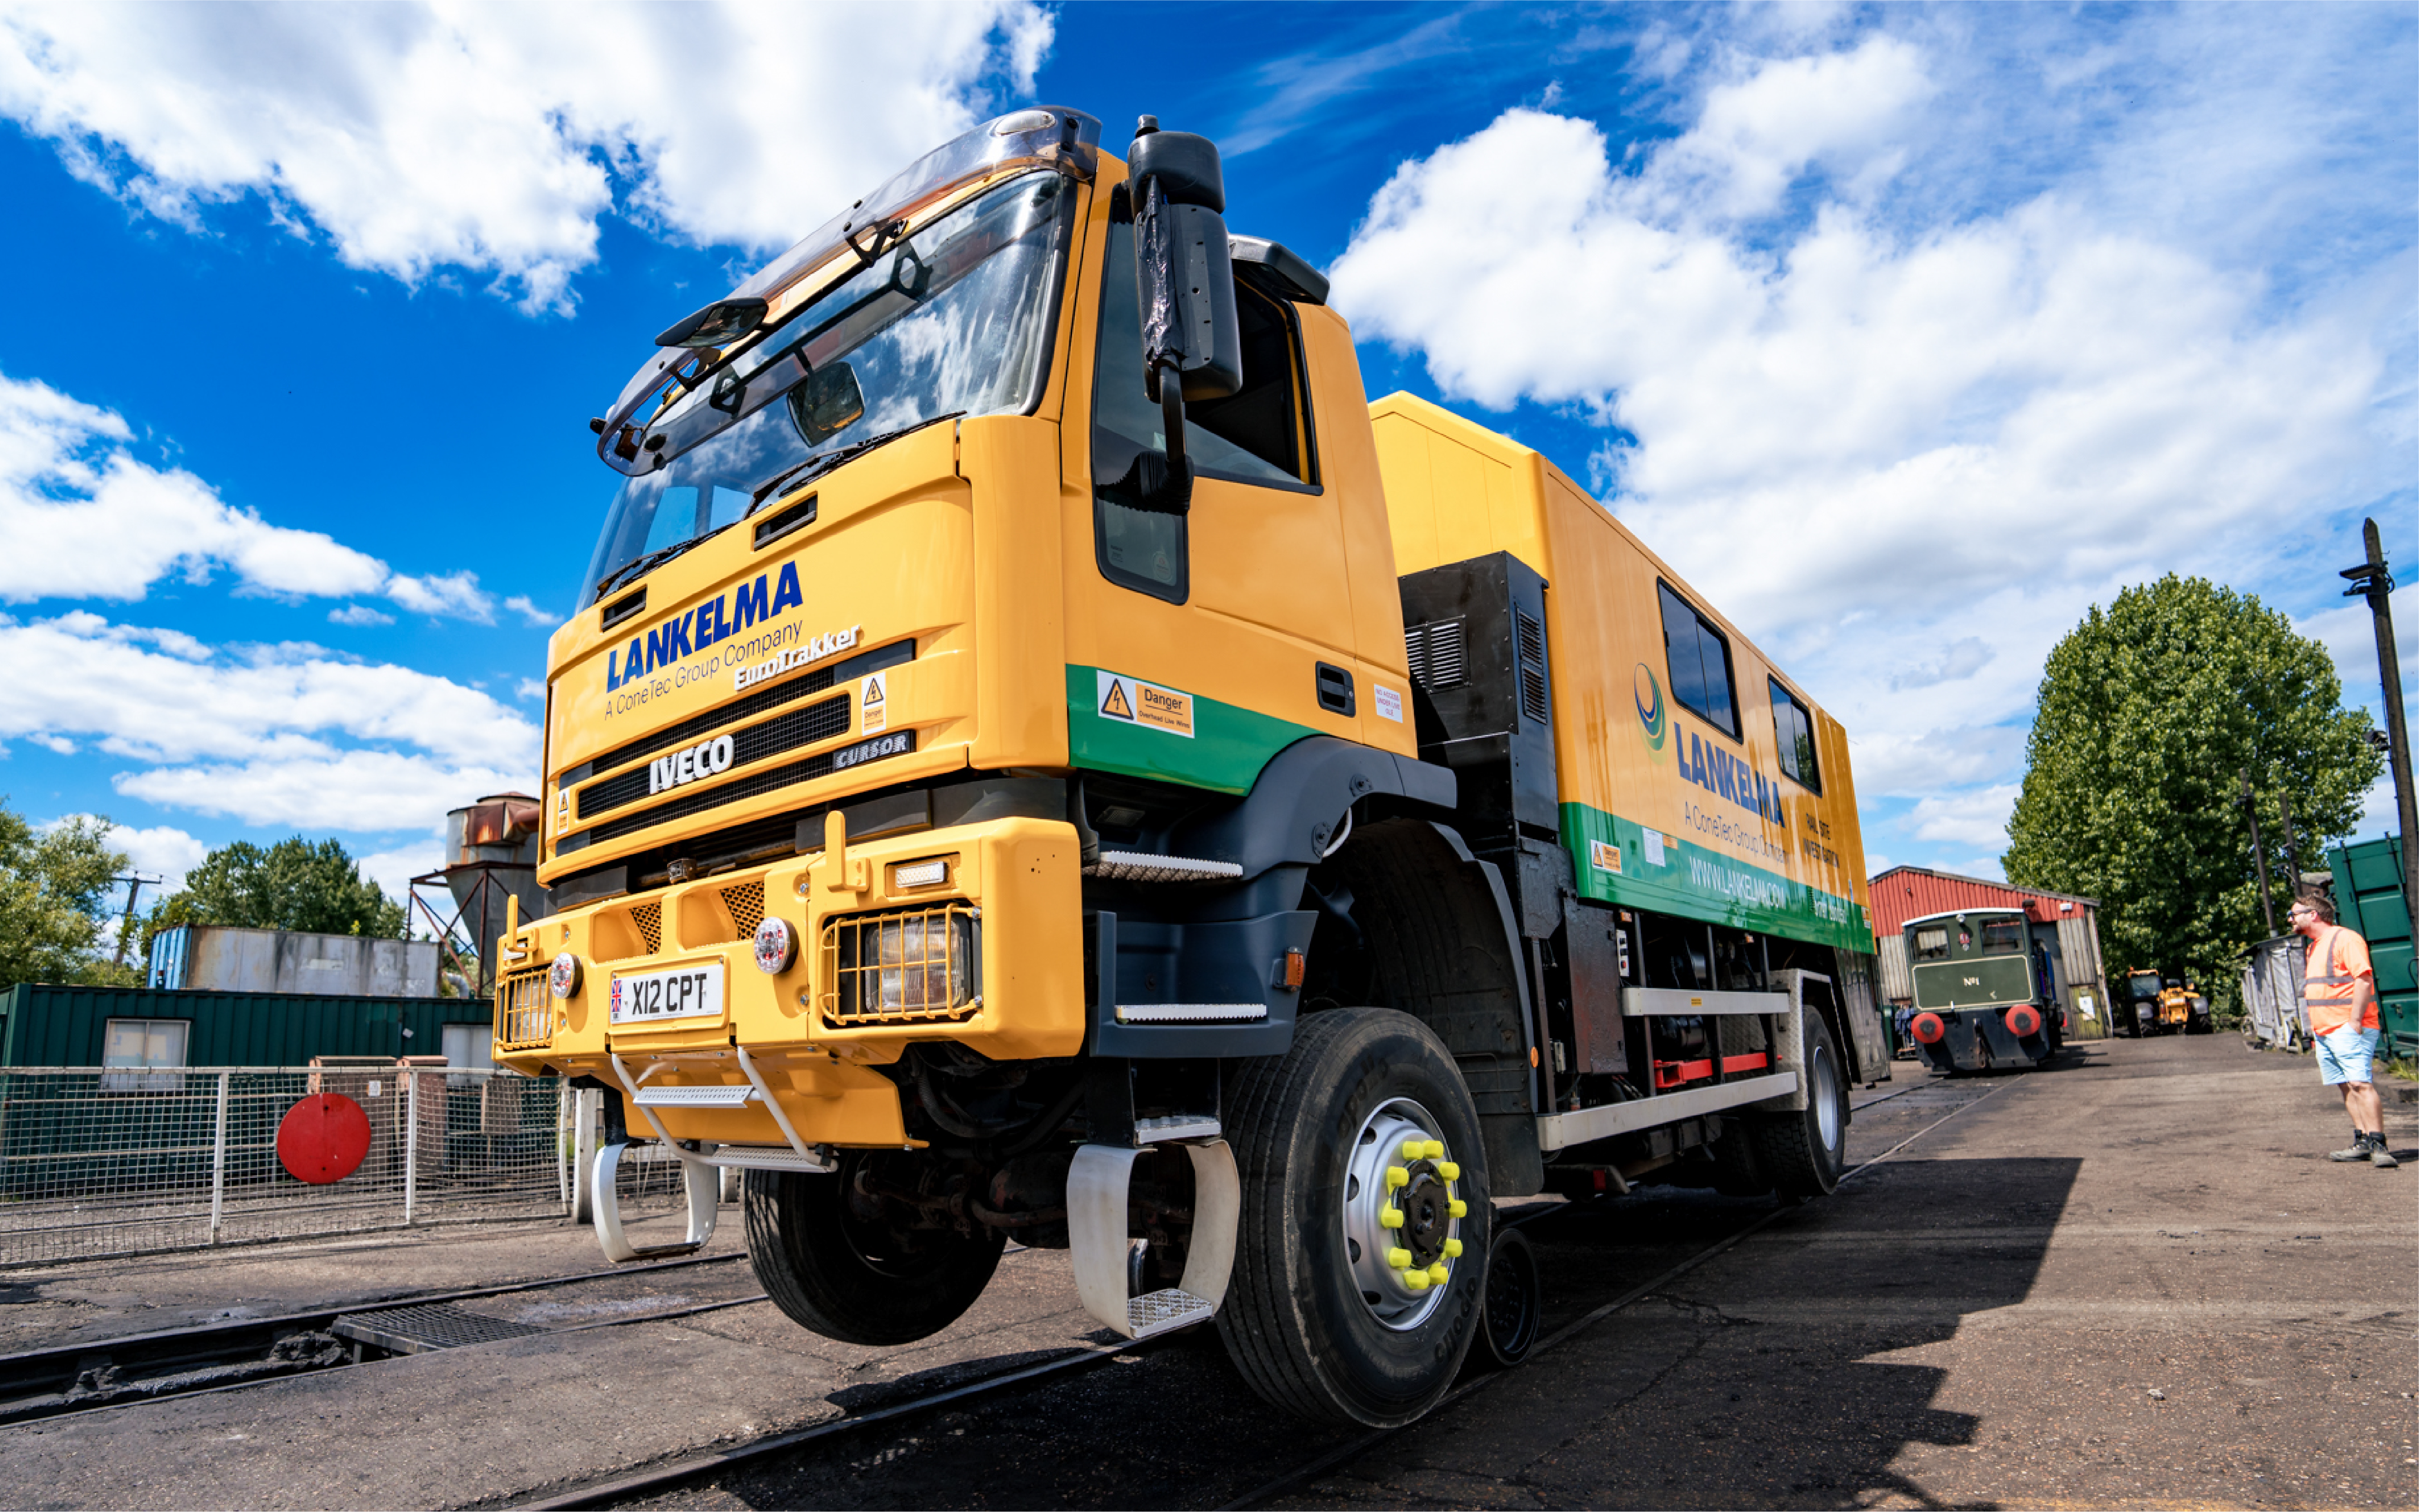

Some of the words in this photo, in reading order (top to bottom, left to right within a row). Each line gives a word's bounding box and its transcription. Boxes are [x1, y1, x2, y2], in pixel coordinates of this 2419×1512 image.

[607, 560, 803, 693] LANKELMA
[605, 700, 612, 720] A
[616, 678, 671, 714] ConeTec
[675, 656, 720, 688] Group
[724, 620, 803, 666] Company
[734, 624, 861, 690] EuroTrakker
[1138, 710, 1164, 722] Overhead
[1145, 689, 1182, 710] Danger
[649, 734, 734, 795] IVECO
[836, 734, 907, 770] CURSOR
[1674, 721, 1786, 828] LANKELMA
[1685, 801, 1692, 827] A
[1693, 805, 1733, 844] ConeTec
[1734, 823, 1758, 857] Group
[632, 979, 661, 1016] X12
[666, 972, 707, 1012] CPT
